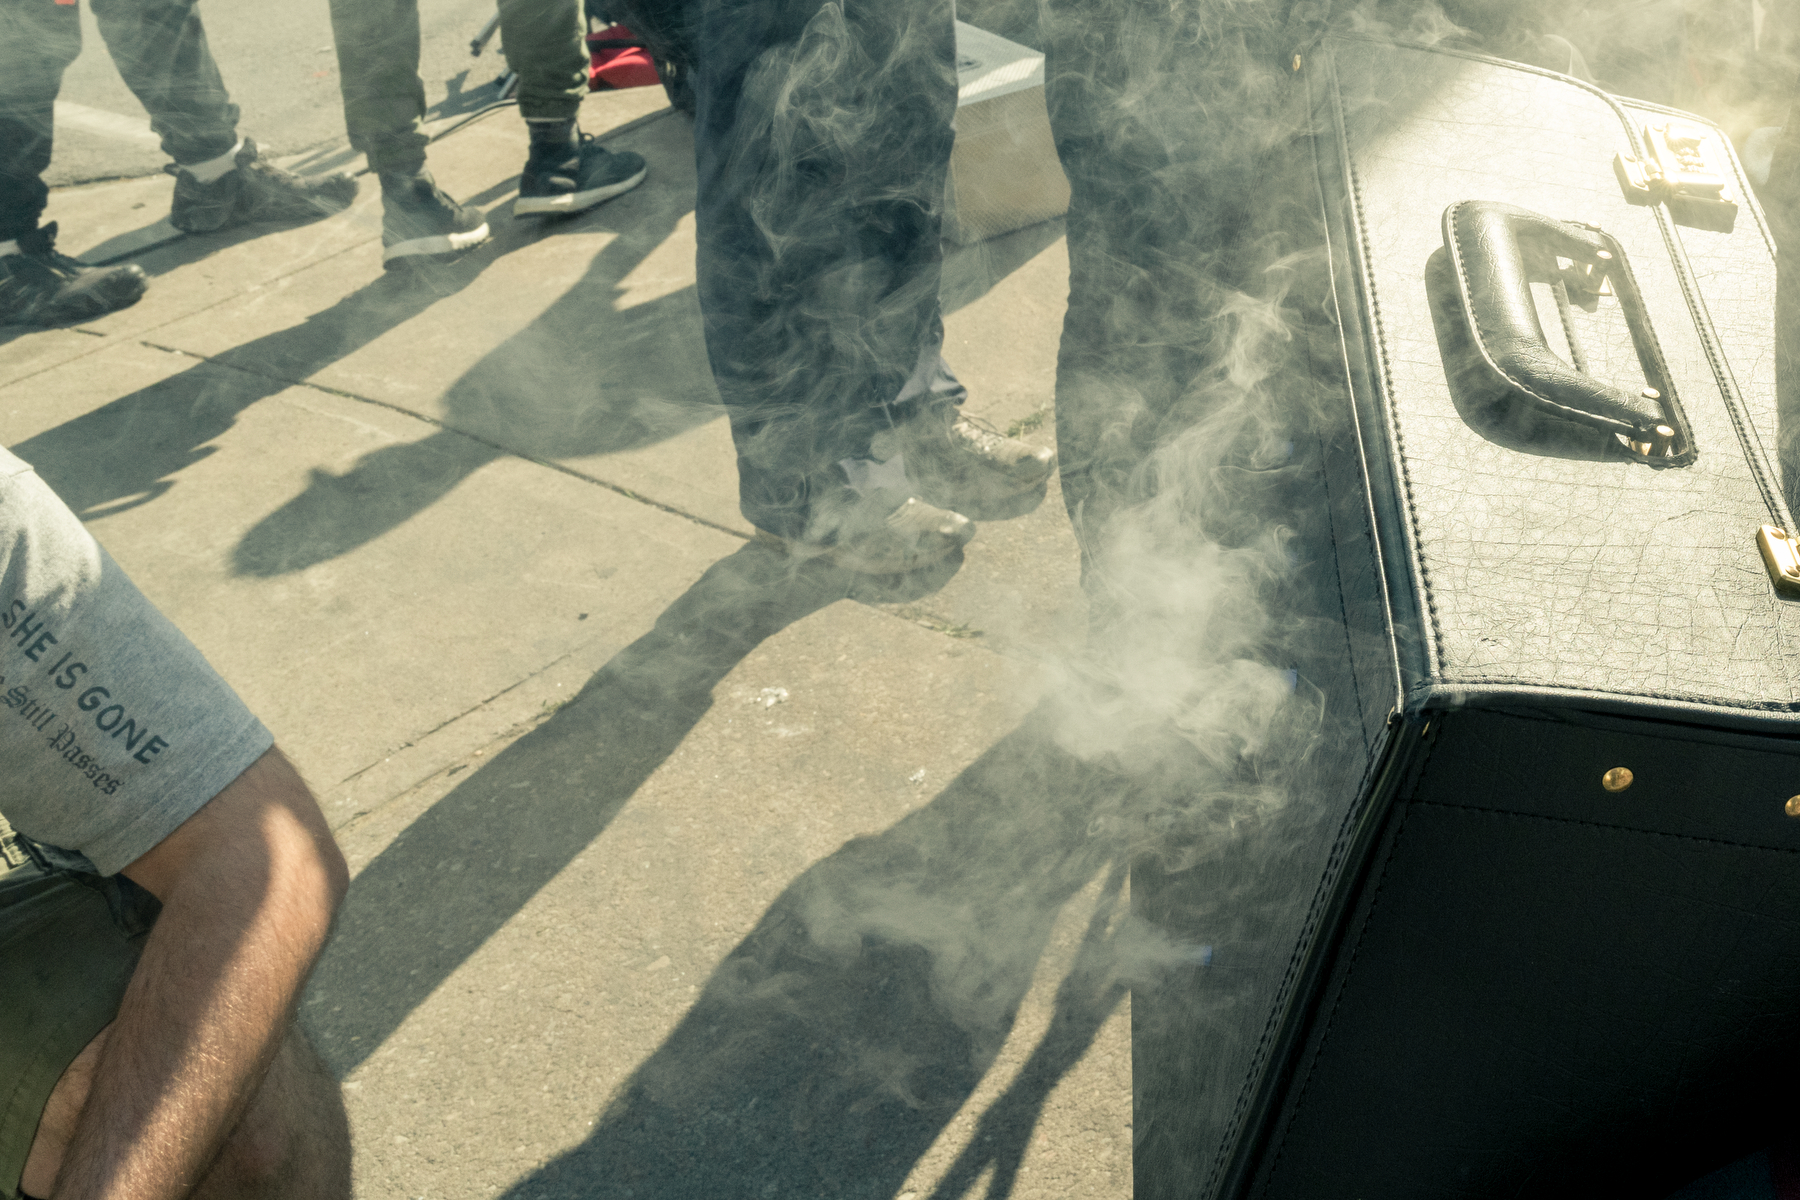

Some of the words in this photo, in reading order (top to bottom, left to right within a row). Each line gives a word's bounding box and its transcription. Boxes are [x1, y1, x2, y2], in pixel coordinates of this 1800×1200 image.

[0, 685, 58, 732] Still
[47, 722, 125, 796] Passes
[2, 599, 59, 663] SHE
[47, 651, 88, 690] IS
[77, 686, 170, 765] GONE
